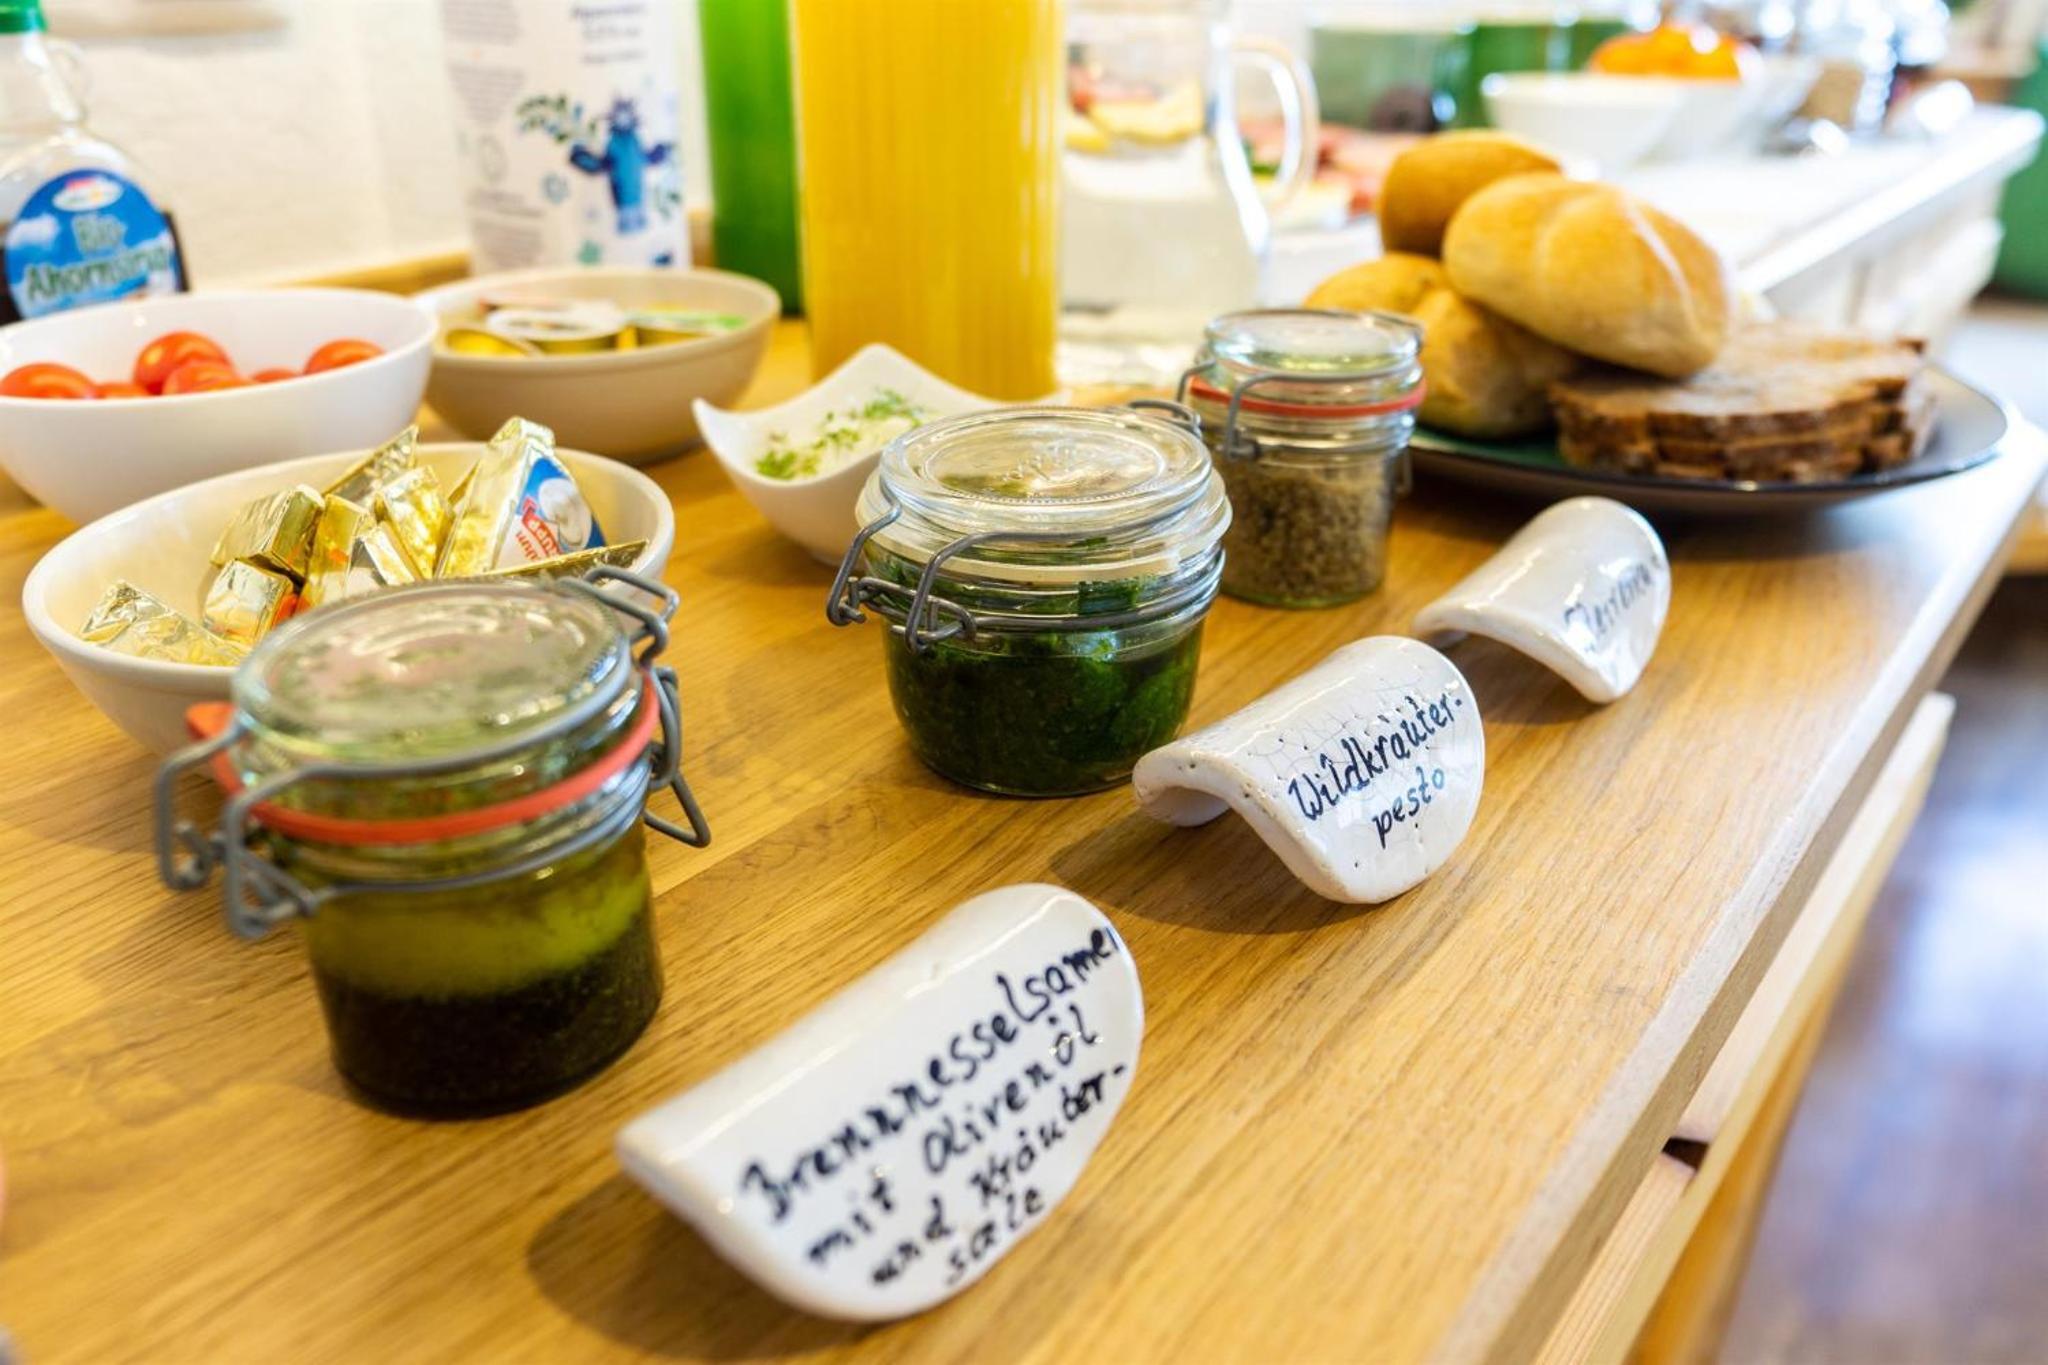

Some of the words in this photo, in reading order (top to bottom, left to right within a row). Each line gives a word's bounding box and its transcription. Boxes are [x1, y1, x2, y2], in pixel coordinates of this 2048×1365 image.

[1372, 765, 1446, 850] pesto
[807, 1170, 896, 1266] mit
[871, 1198, 953, 1287] und
